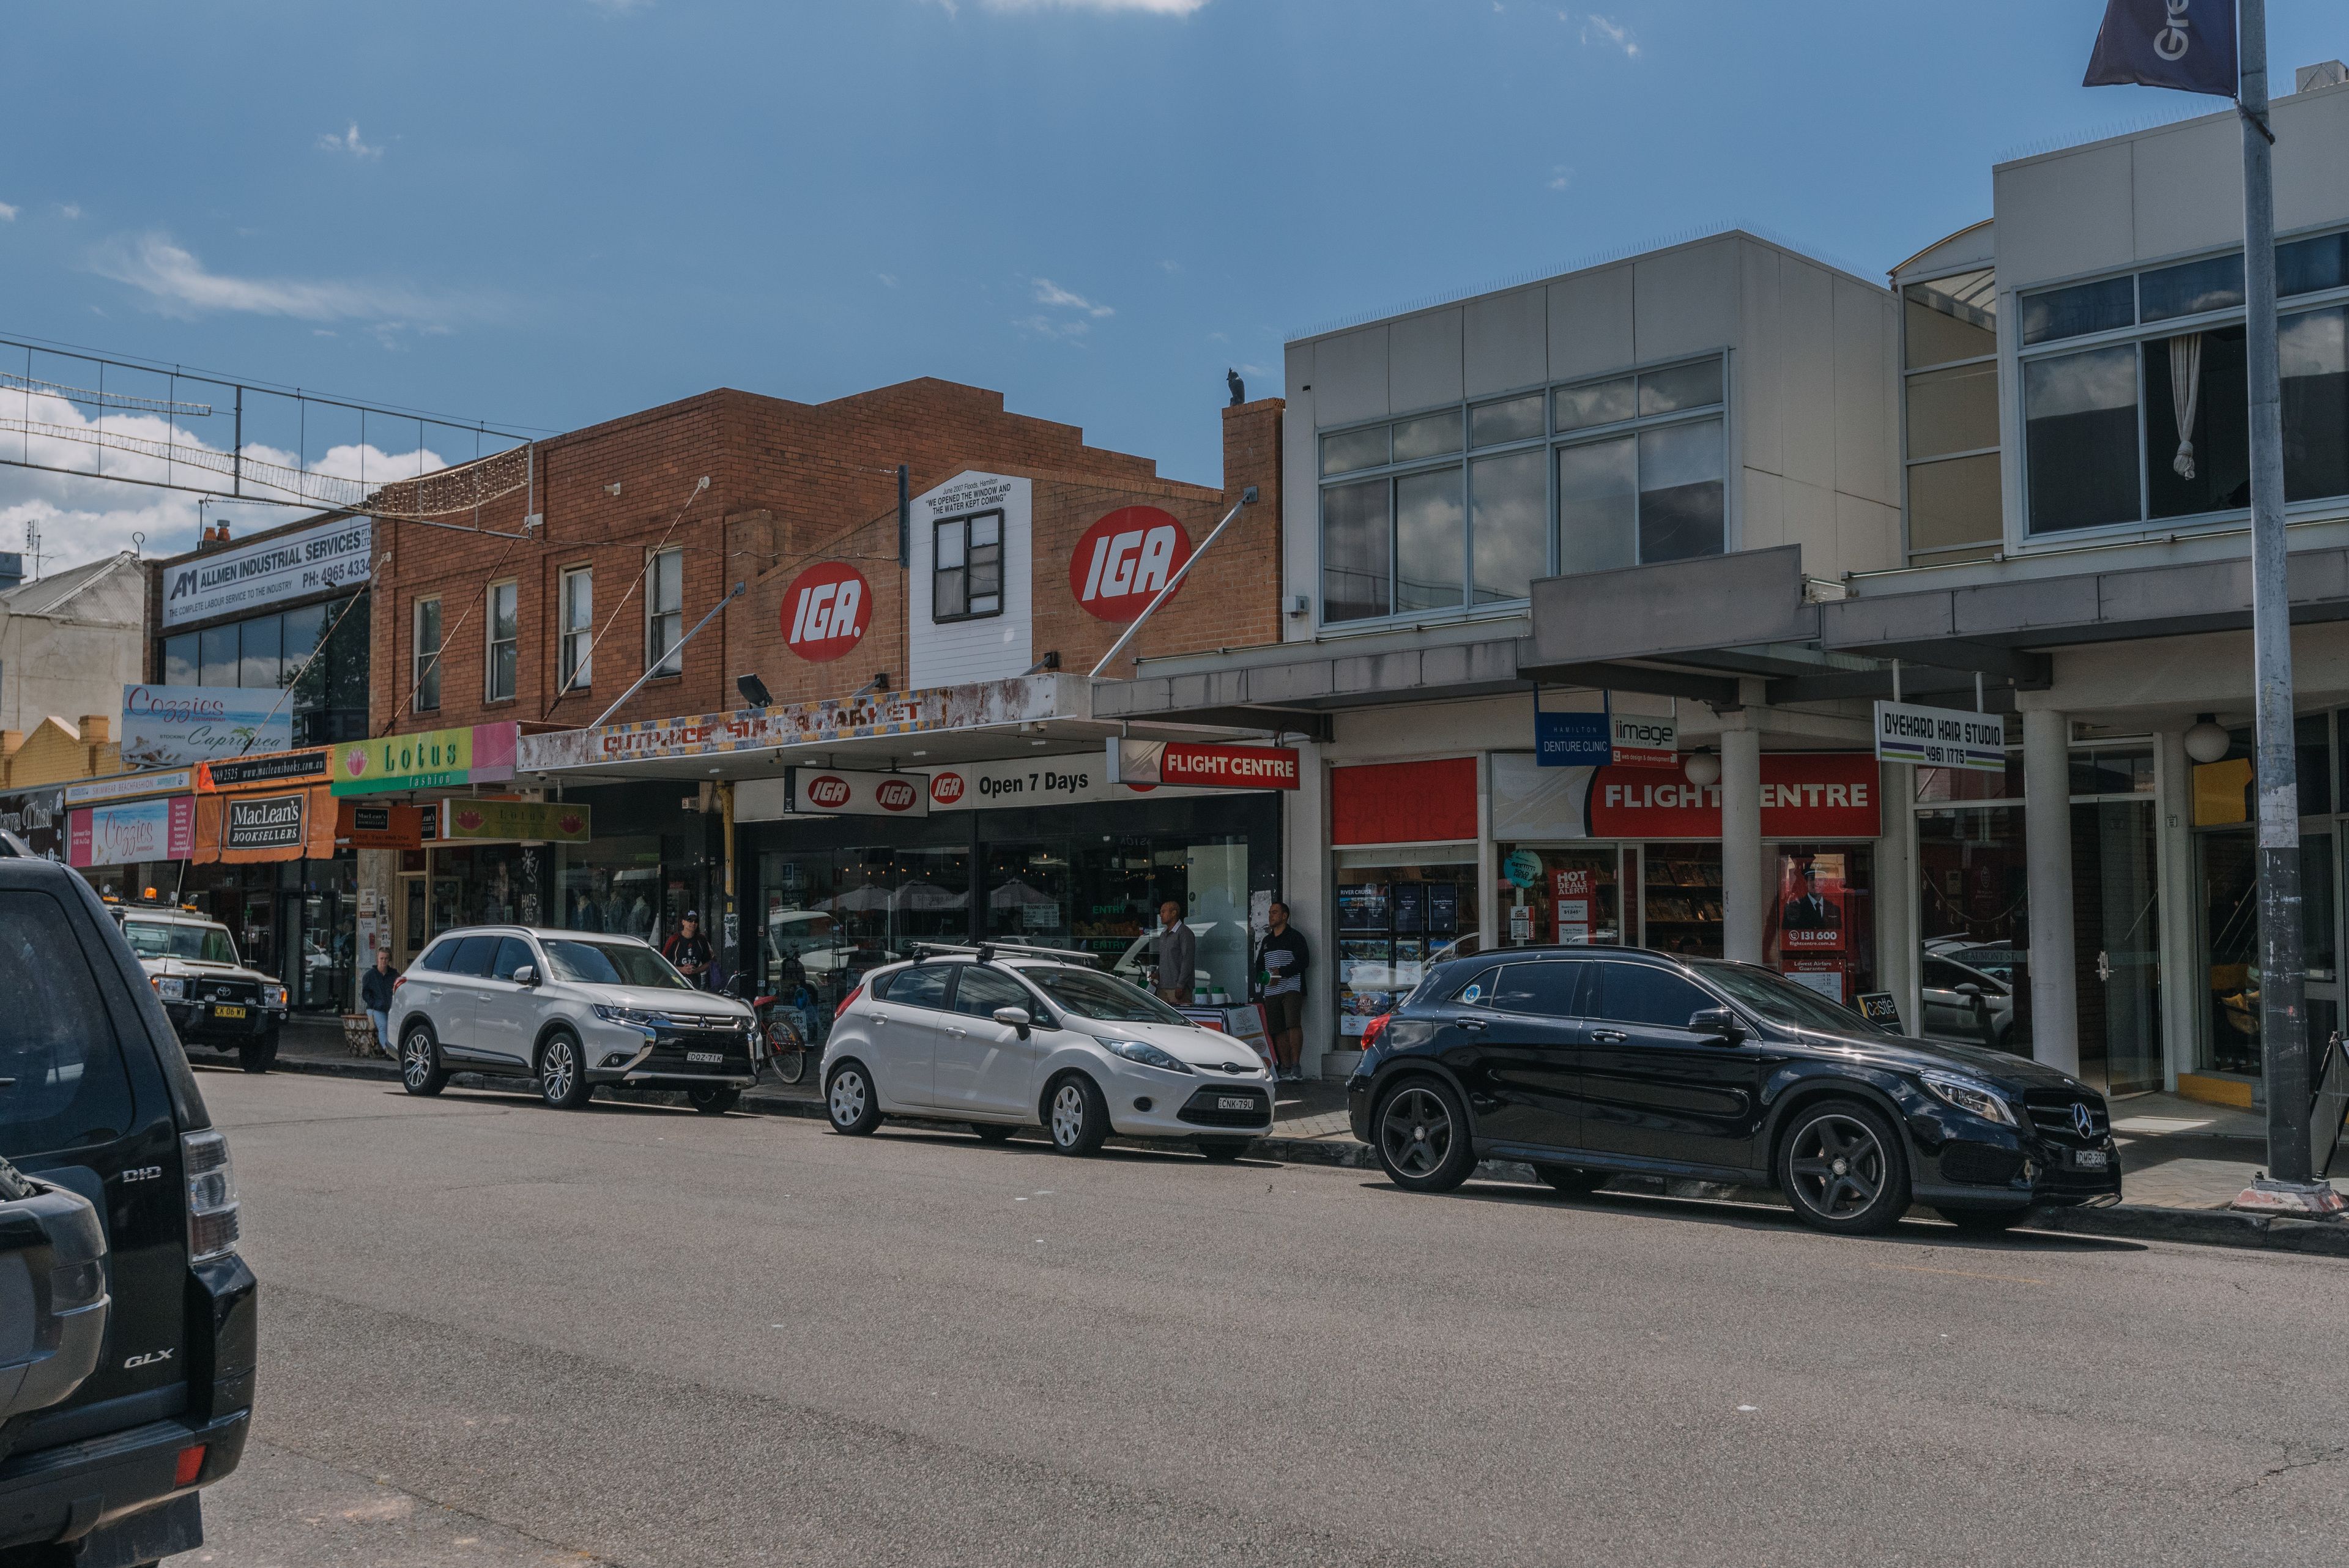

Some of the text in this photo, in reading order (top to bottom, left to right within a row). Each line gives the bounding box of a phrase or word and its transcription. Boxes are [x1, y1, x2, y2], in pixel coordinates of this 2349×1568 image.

[938, 494, 960, 505] OPENED
[961, 491, 972, 500] THE
[973, 486, 998, 498] WINDOW
[998, 483, 1011, 492] AND
[964, 482, 978, 491] Floods,
[979, 478, 998, 488] Hamilton
[932, 506, 943, 515] THE
[944, 502, 964, 513] WATER
[965, 498, 980, 509] KEPT
[362, 529, 371, 538] PTY
[362, 537, 371, 546] LTD
[201, 532, 361, 588] ALLMEN INDUSTRIAL SERVICES
[302, 571, 319, 589] PH:
[321, 563, 345, 584] 4965
[169, 580, 292, 618] THE COMPLETE LABOUR SERVICE TO THE INDUSTRY
[128, 687, 223, 723] Cozzies
[1884, 713, 2000, 746] DYEHARD HAIR STUDIO
[1544, 740, 1581, 752] DENTURE
[1583, 740, 1608, 752] CLINIC
[1926, 745, 1965, 764] 4961 1775
[383, 740, 457, 772] Lotus
[223, 768, 239, 780] 2525
[243, 759, 323, 778] www.macleansbooks.com.au
[1168, 754, 1294, 778] FLIGHT CENTRE
[118, 779, 153, 791] BEACHFASHION
[409, 774, 451, 788] fashion
[979, 771, 1089, 798] Open 7 Days
[812, 781, 847, 801] IGA
[880, 786, 913, 805] IGA
[1605, 783, 1868, 808] FLIGHT ENTRE
[23, 800, 53, 829] Thai
[105, 812, 154, 856] Cozzies
[232, 827, 297, 842] BOOKSELLERS
[1557, 871, 1587, 883] HOT
[1557, 880, 1587, 890] DEALS
[522, 893, 537, 909] HATS
[1092, 905, 1126, 914] ENTRY
[1092, 940, 1127, 949] ENTRY
[1800, 931, 1838, 940] 131 600
[1961, 951, 2003, 961] BEAUMONT
[1867, 998, 1896, 1017] castle
[124, 1348, 175, 1370] GLX
